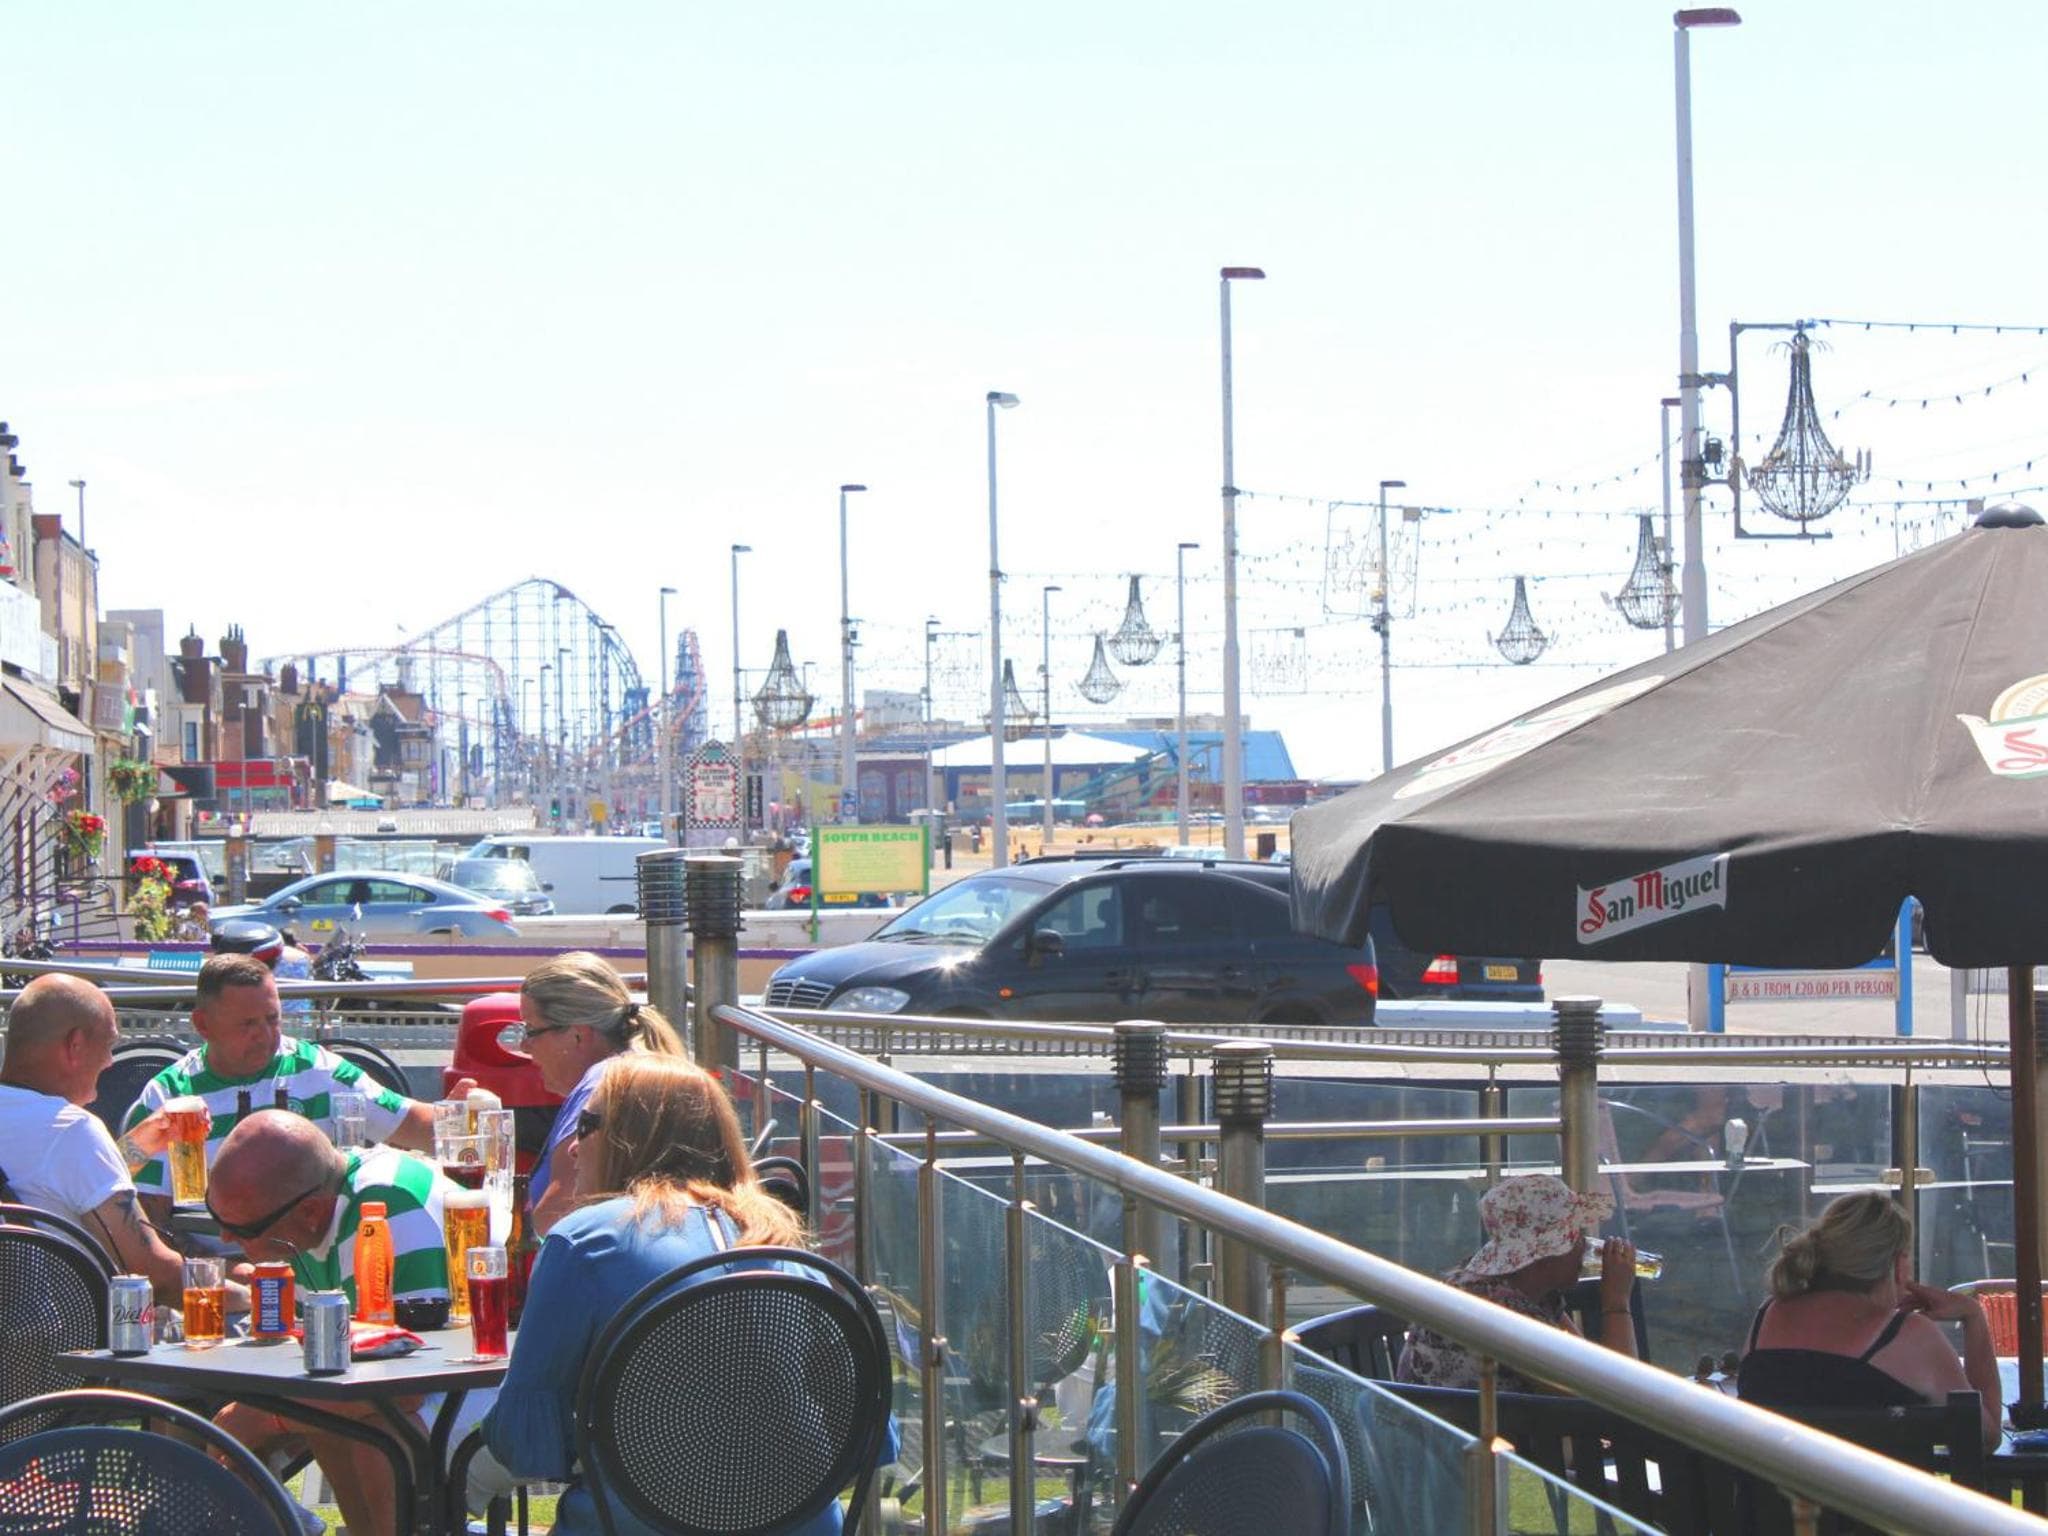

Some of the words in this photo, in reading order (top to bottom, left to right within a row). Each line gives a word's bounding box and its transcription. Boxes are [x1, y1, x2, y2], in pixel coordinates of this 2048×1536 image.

[823, 832, 869, 843] SOUTH
[872, 832, 919, 842] BEACH
[1580, 887, 1634, 934] San
[1632, 861, 1721, 910] Miguel
[1730, 982, 1738, 996] B
[1742, 982, 1750, 996] &
[1753, 981, 1760, 996] B
[1764, 981, 1791, 996] FROM
[1832, 980, 1851, 995] PER
[1854, 980, 1893, 995] PERSON
